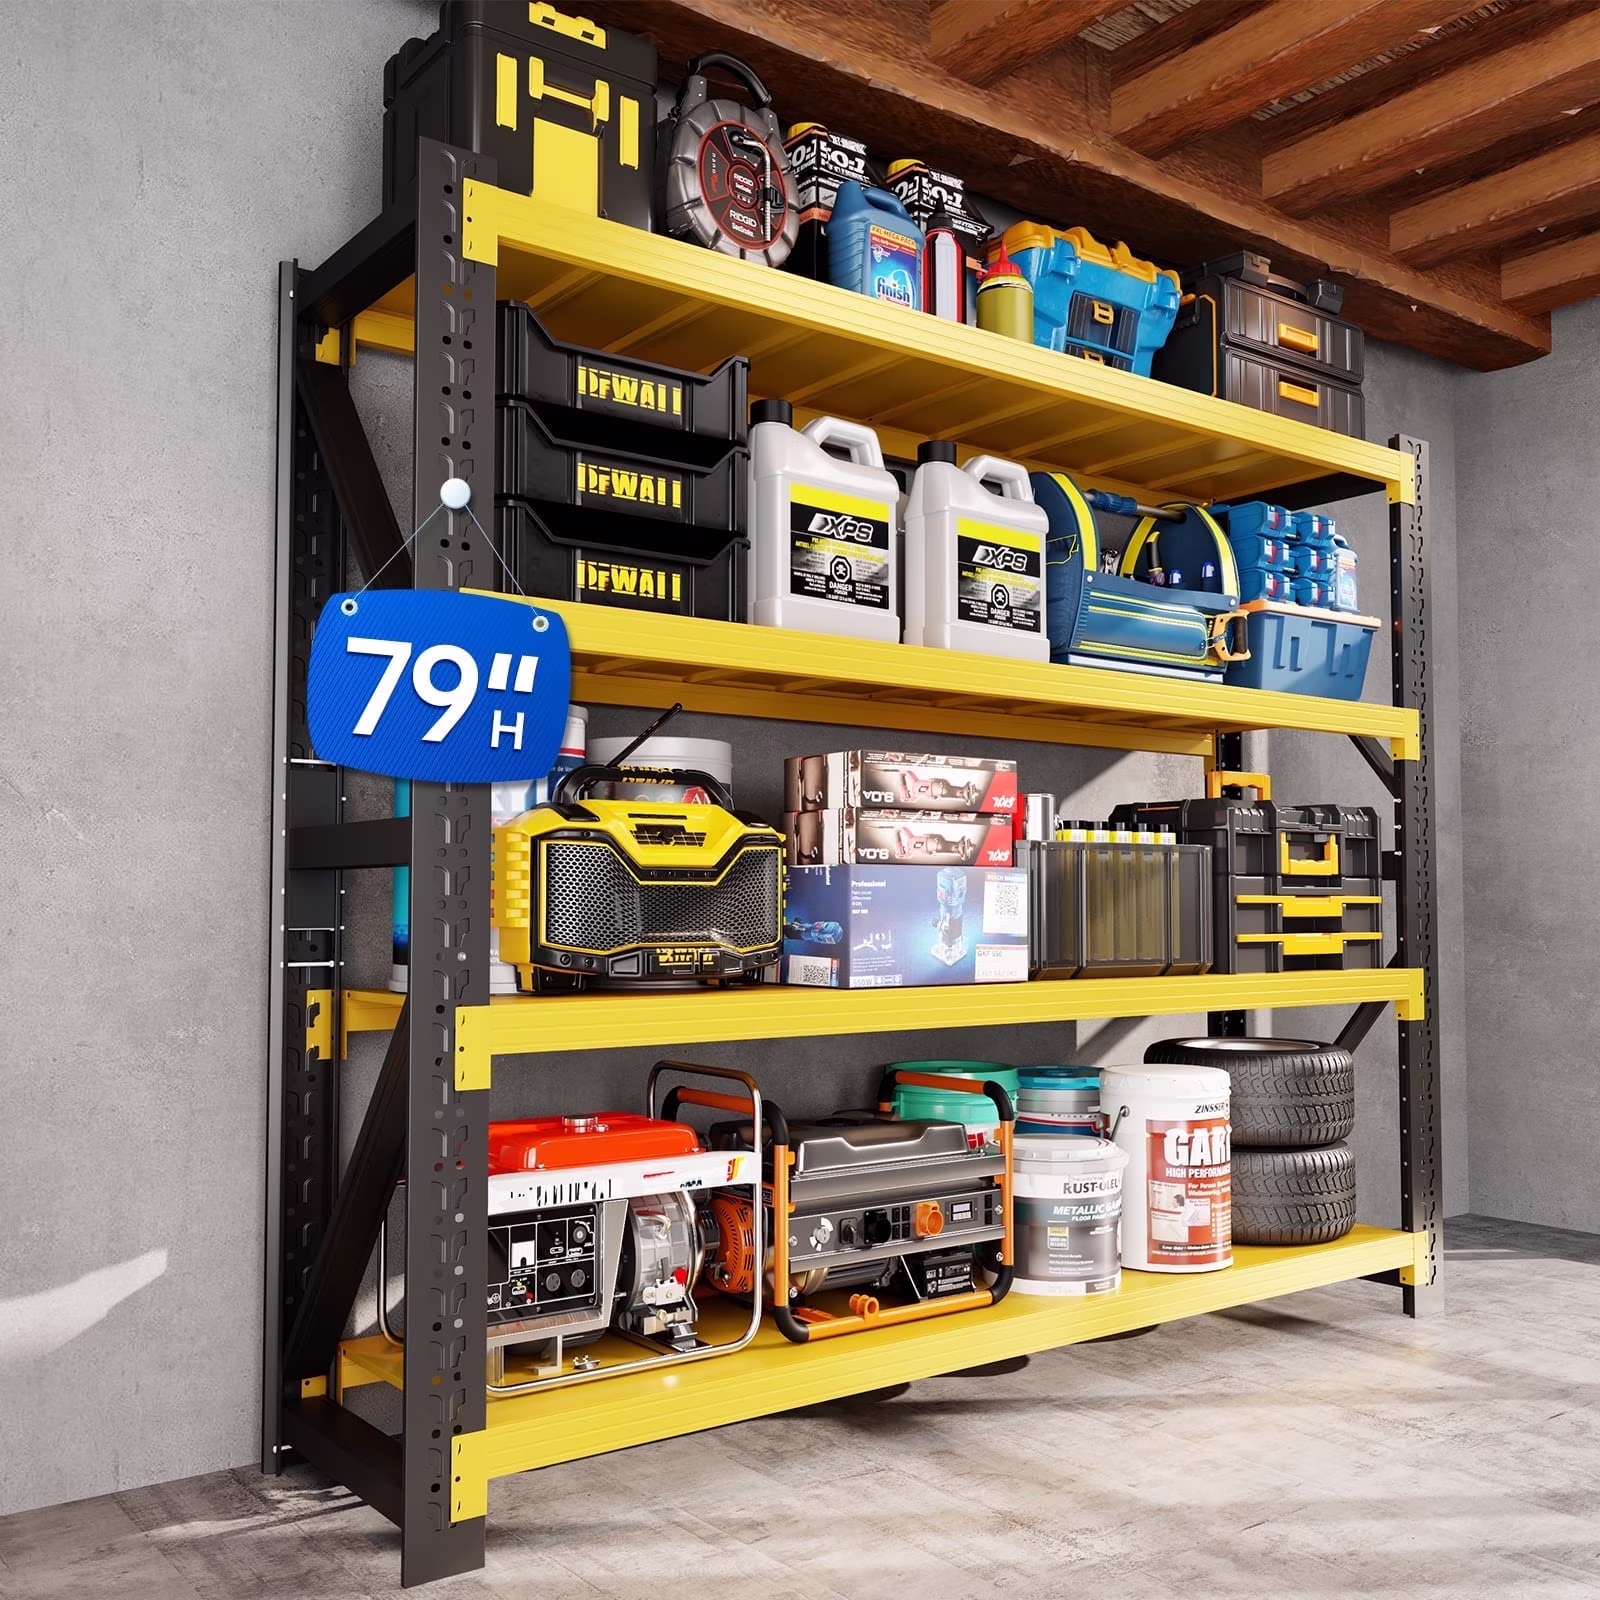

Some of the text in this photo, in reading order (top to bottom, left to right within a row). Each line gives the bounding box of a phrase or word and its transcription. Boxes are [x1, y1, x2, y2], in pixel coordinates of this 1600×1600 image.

[734, 172, 753, 187] RIDGID
[729, 209, 757, 228] RIDGID
[877, 277, 910, 303] finish
[814, 513, 874, 543] XPS
[978, 545, 1028, 571] XPS
[829, 581, 853, 593] DANGER
[1194, 1102, 1225, 1114] ZINSSER
[1165, 1167, 1187, 1177] HIGH
[1053, 1203, 1106, 1216] METALLIC
